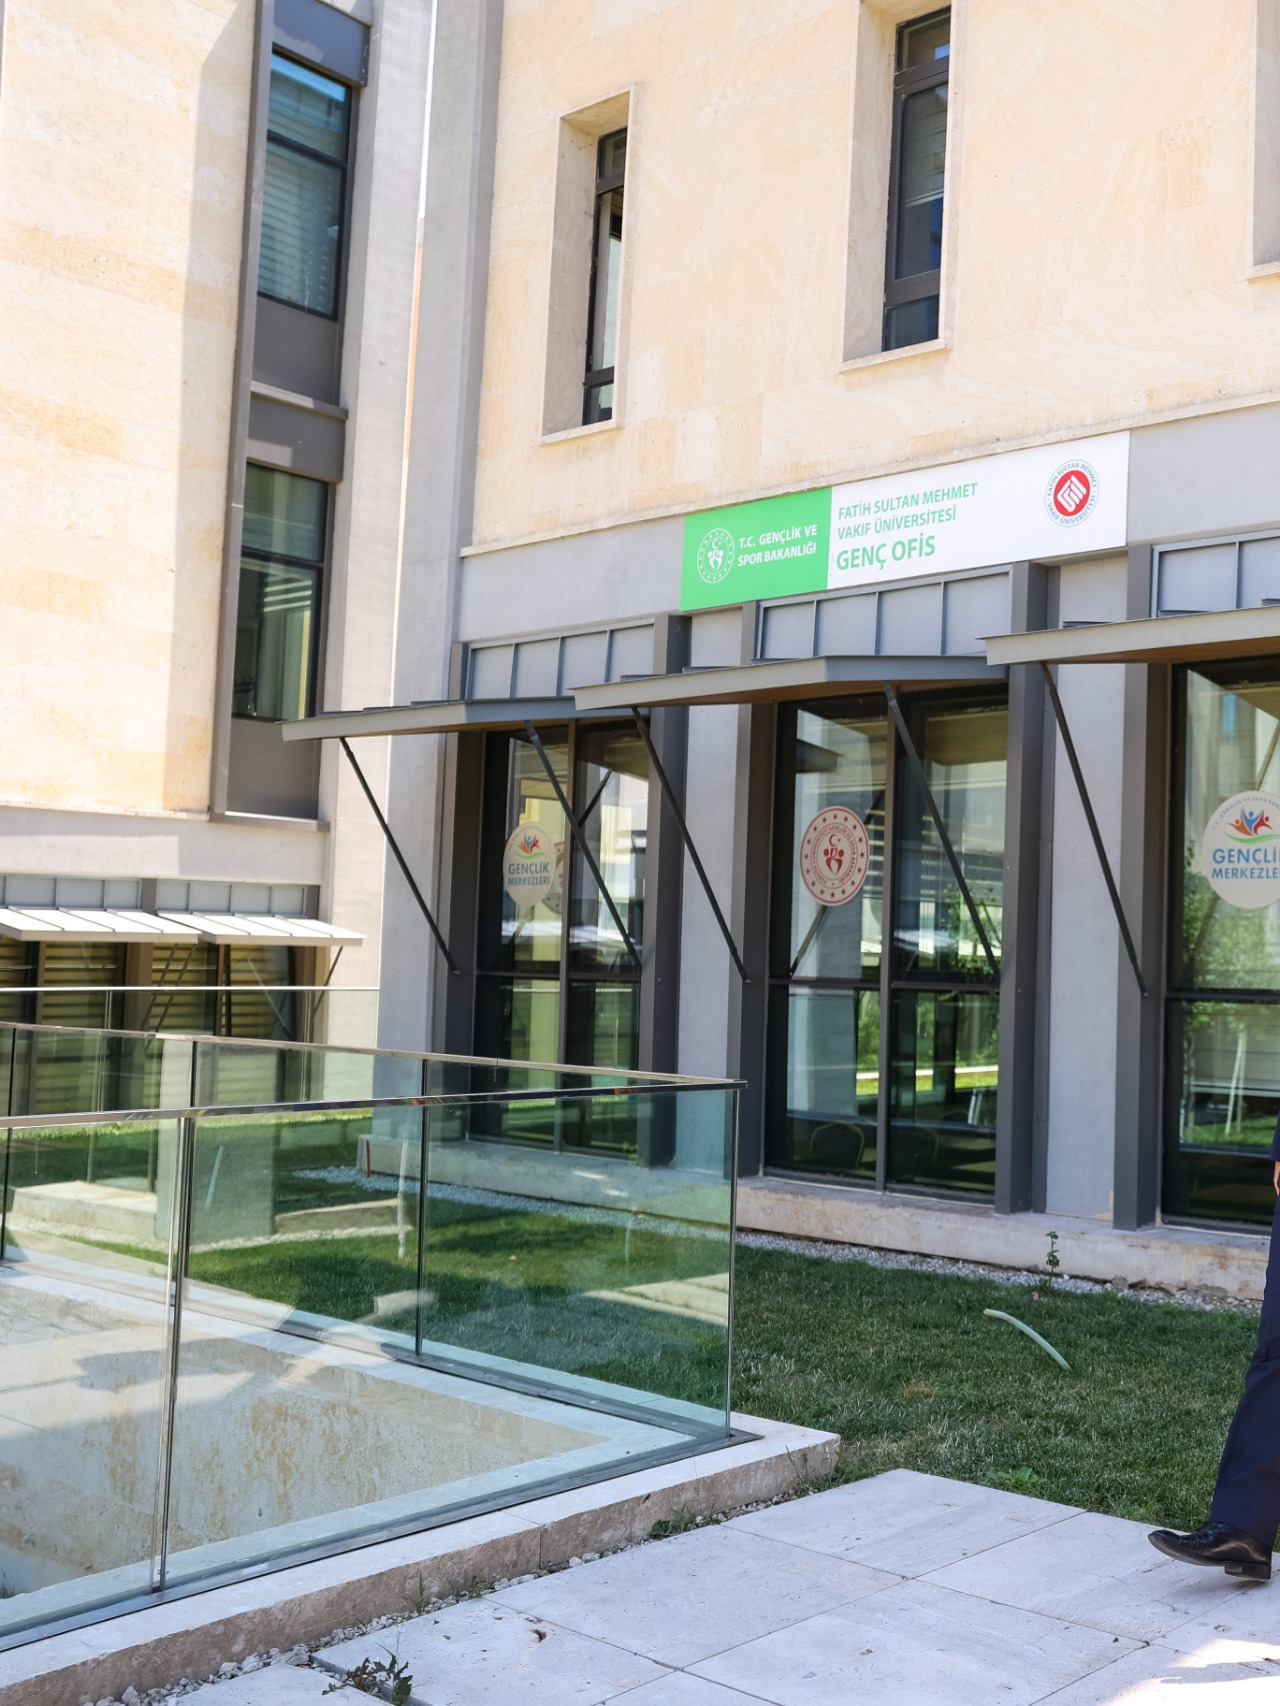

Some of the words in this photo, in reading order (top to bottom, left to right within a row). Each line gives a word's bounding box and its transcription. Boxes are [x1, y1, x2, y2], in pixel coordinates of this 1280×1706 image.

[838, 501, 871, 520] FATİH
[874, 493, 920, 514] SULTAN
[922, 482, 978, 505] MEHMET
[837, 522, 871, 540] VAKIF
[874, 504, 957, 534] ÜNİVERSİTESİ
[739, 536, 756, 549] T.C.
[759, 526, 801, 545] GENÇLİK
[804, 524, 818, 537] VE
[738, 551, 762, 567] SPOR
[764, 541, 817, 562] BAKANLIĞI
[836, 543, 887, 571] GENÇ
[891, 532, 936, 562] OFİS
[508, 861, 549, 875] GENÇLİK
[508, 876, 549, 886] MERKEZLERİ
